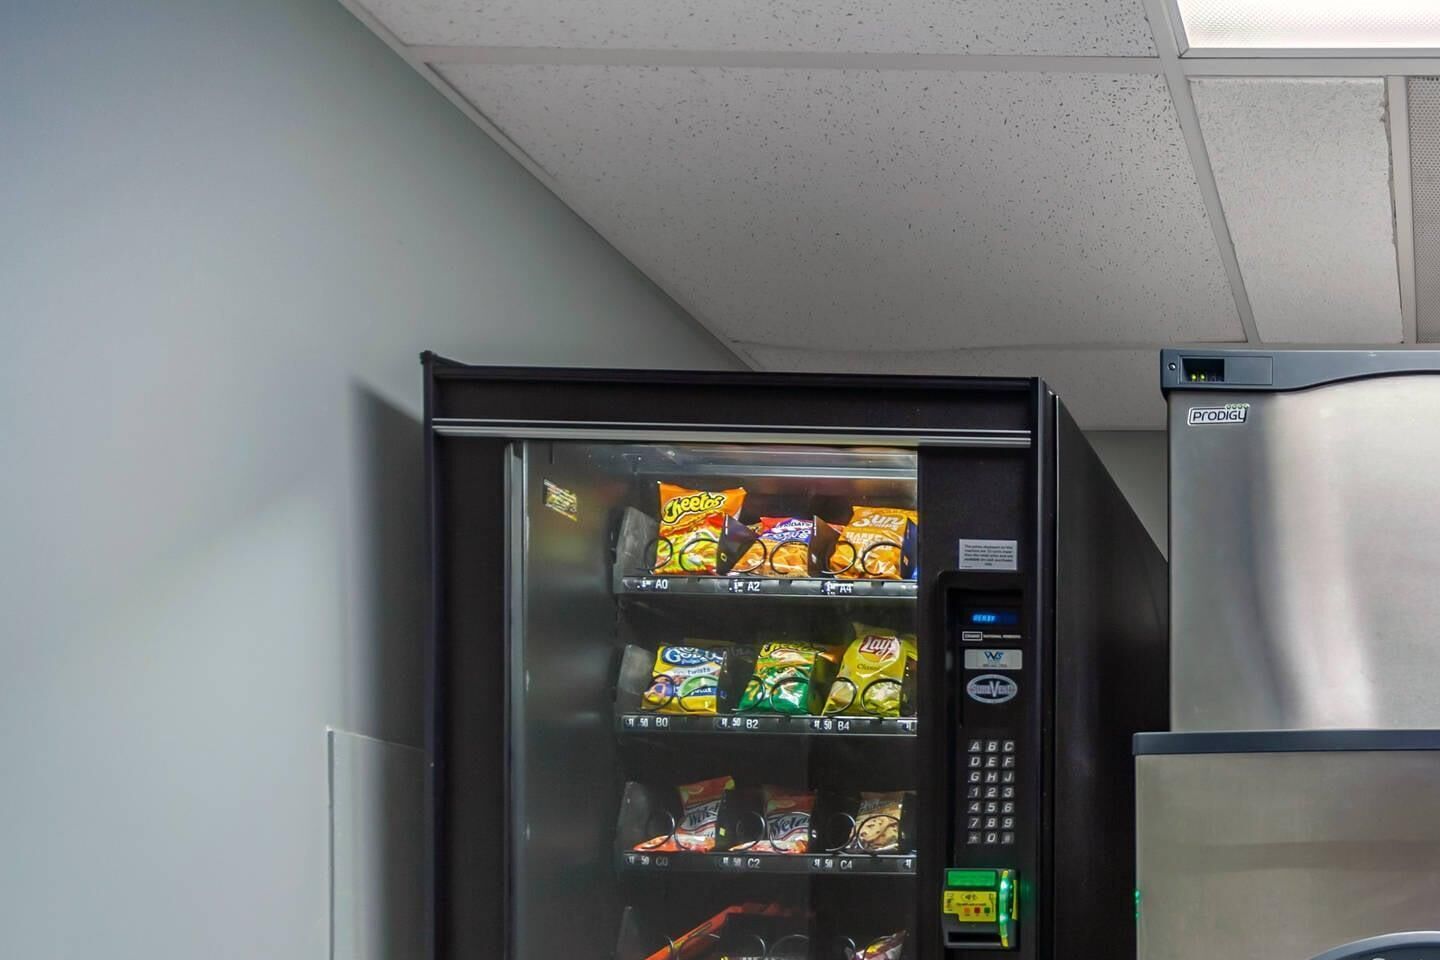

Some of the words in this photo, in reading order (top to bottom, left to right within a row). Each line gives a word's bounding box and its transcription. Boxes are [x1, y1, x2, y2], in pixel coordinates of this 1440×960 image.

[665, 491, 725, 523] Cheetos
[655, 579, 668, 589] A0
[747, 581, 760, 591] A2
[861, 637, 896, 660] Lay
[655, 717, 668, 727] B0
[746, 719, 759, 729] B2
[837, 720, 850, 731] B4
[971, 741, 980, 751] A
[988, 741, 997, 751] B
[1004, 741, 1014, 751] C
[971, 757, 980, 766] D
[988, 757, 997, 766] E
[1004, 757, 1013, 766] F
[970, 772, 980, 781] G
[987, 772, 997, 781] H
[1004, 772, 1012, 782] J
[972, 787, 979, 797] 1
[987, 787, 996, 797] 2
[1004, 787, 1013, 797] 3
[971, 802, 979, 812] 4
[987, 802, 996, 812] 5
[1004, 802, 1013, 812] 6
[971, 817, 979, 827] 7
[987, 817, 996, 828] 8
[1004, 818, 1013, 828] 9
[987, 833, 996, 843] 0
[747, 858, 760, 869] C2
[840, 860, 853, 869] C4
